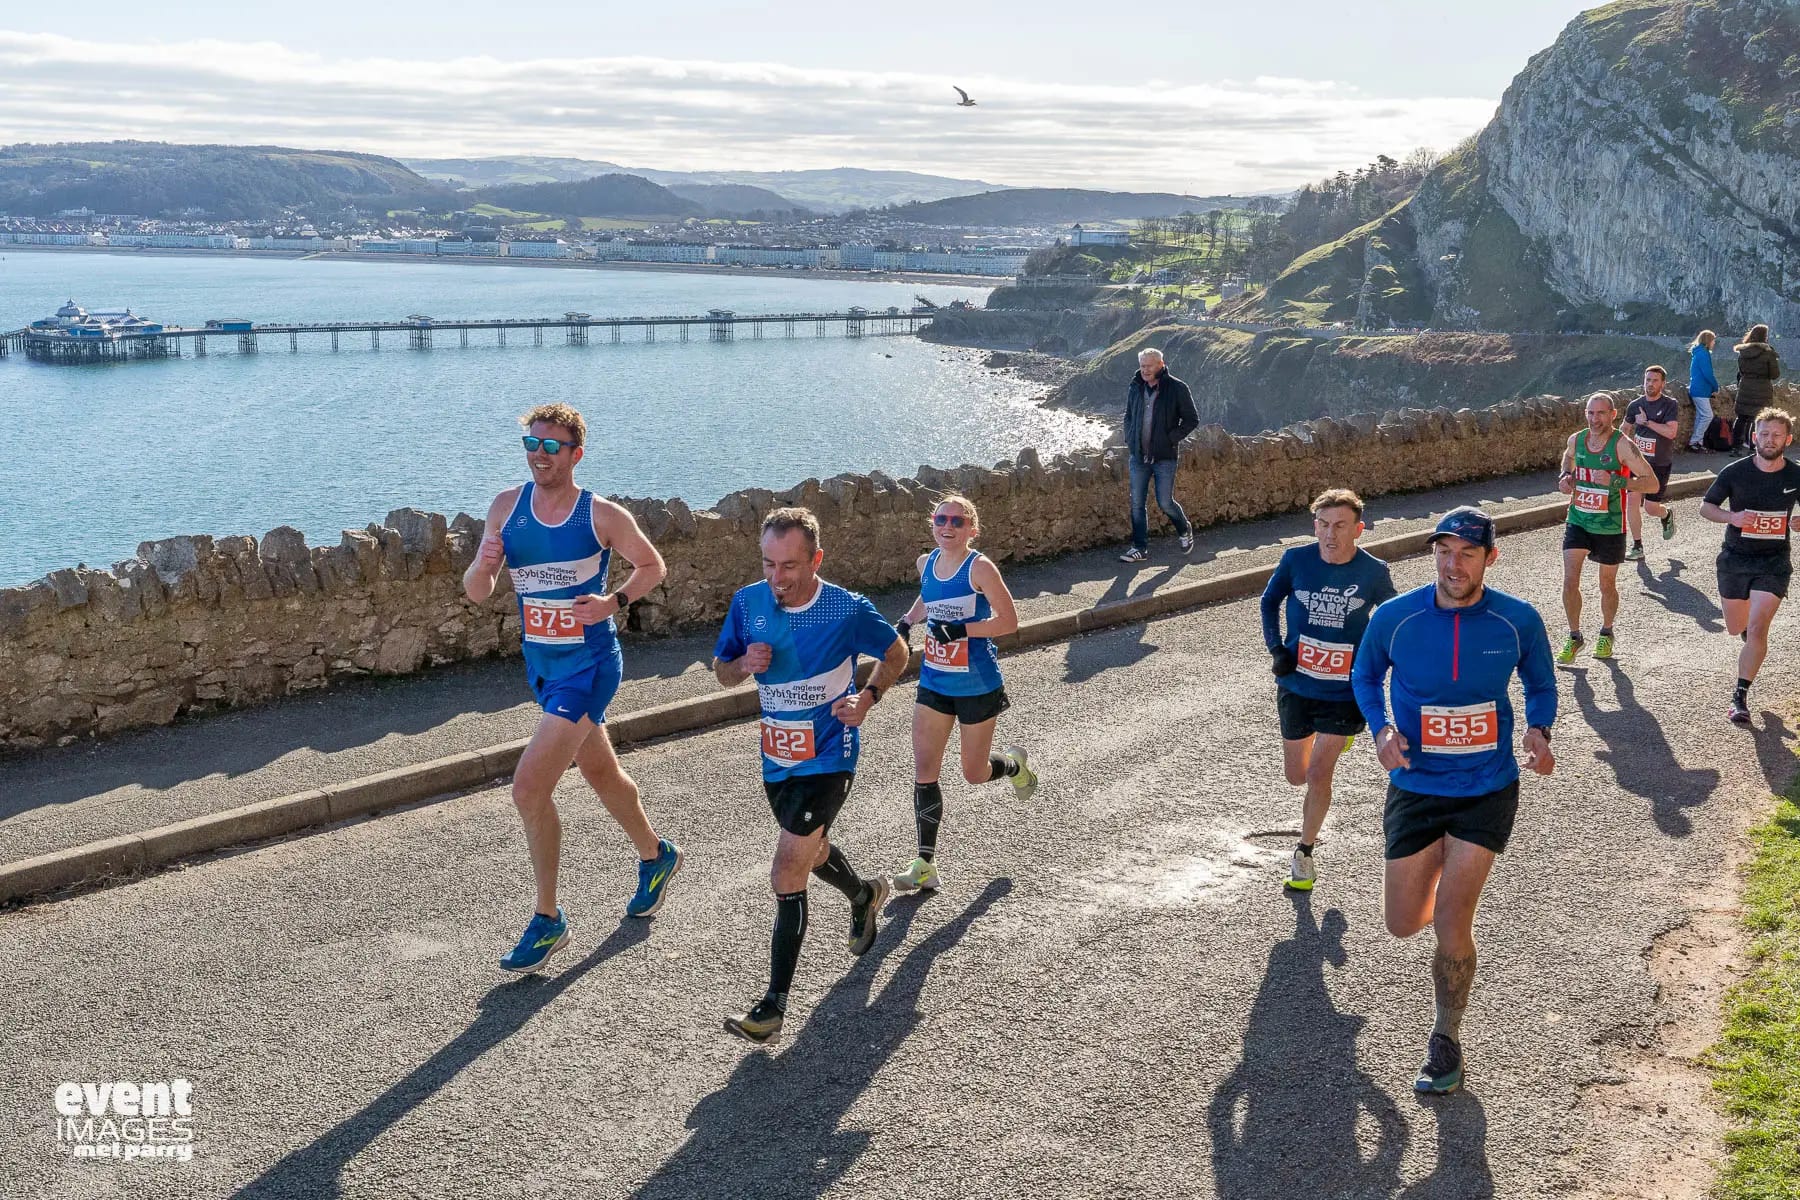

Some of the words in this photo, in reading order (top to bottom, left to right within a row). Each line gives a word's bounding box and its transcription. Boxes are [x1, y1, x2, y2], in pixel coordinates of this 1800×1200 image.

[1577, 492, 1603, 506] 441
[1311, 592, 1349, 605] OULTON
[1309, 600, 1347, 616] PARK
[529, 607, 576, 629] 375
[1308, 617, 1345, 629] FINISHER
[547, 628, 557, 636] ED
[926, 637, 960, 659] 367
[933, 656, 951, 665] EMMA
[1301, 645, 1345, 668] 276
[1311, 665, 1331, 673] DAVID
[1428, 714, 1488, 737] 355
[765, 726, 807, 752] 122
[1445, 737, 1473, 745] SALTY
